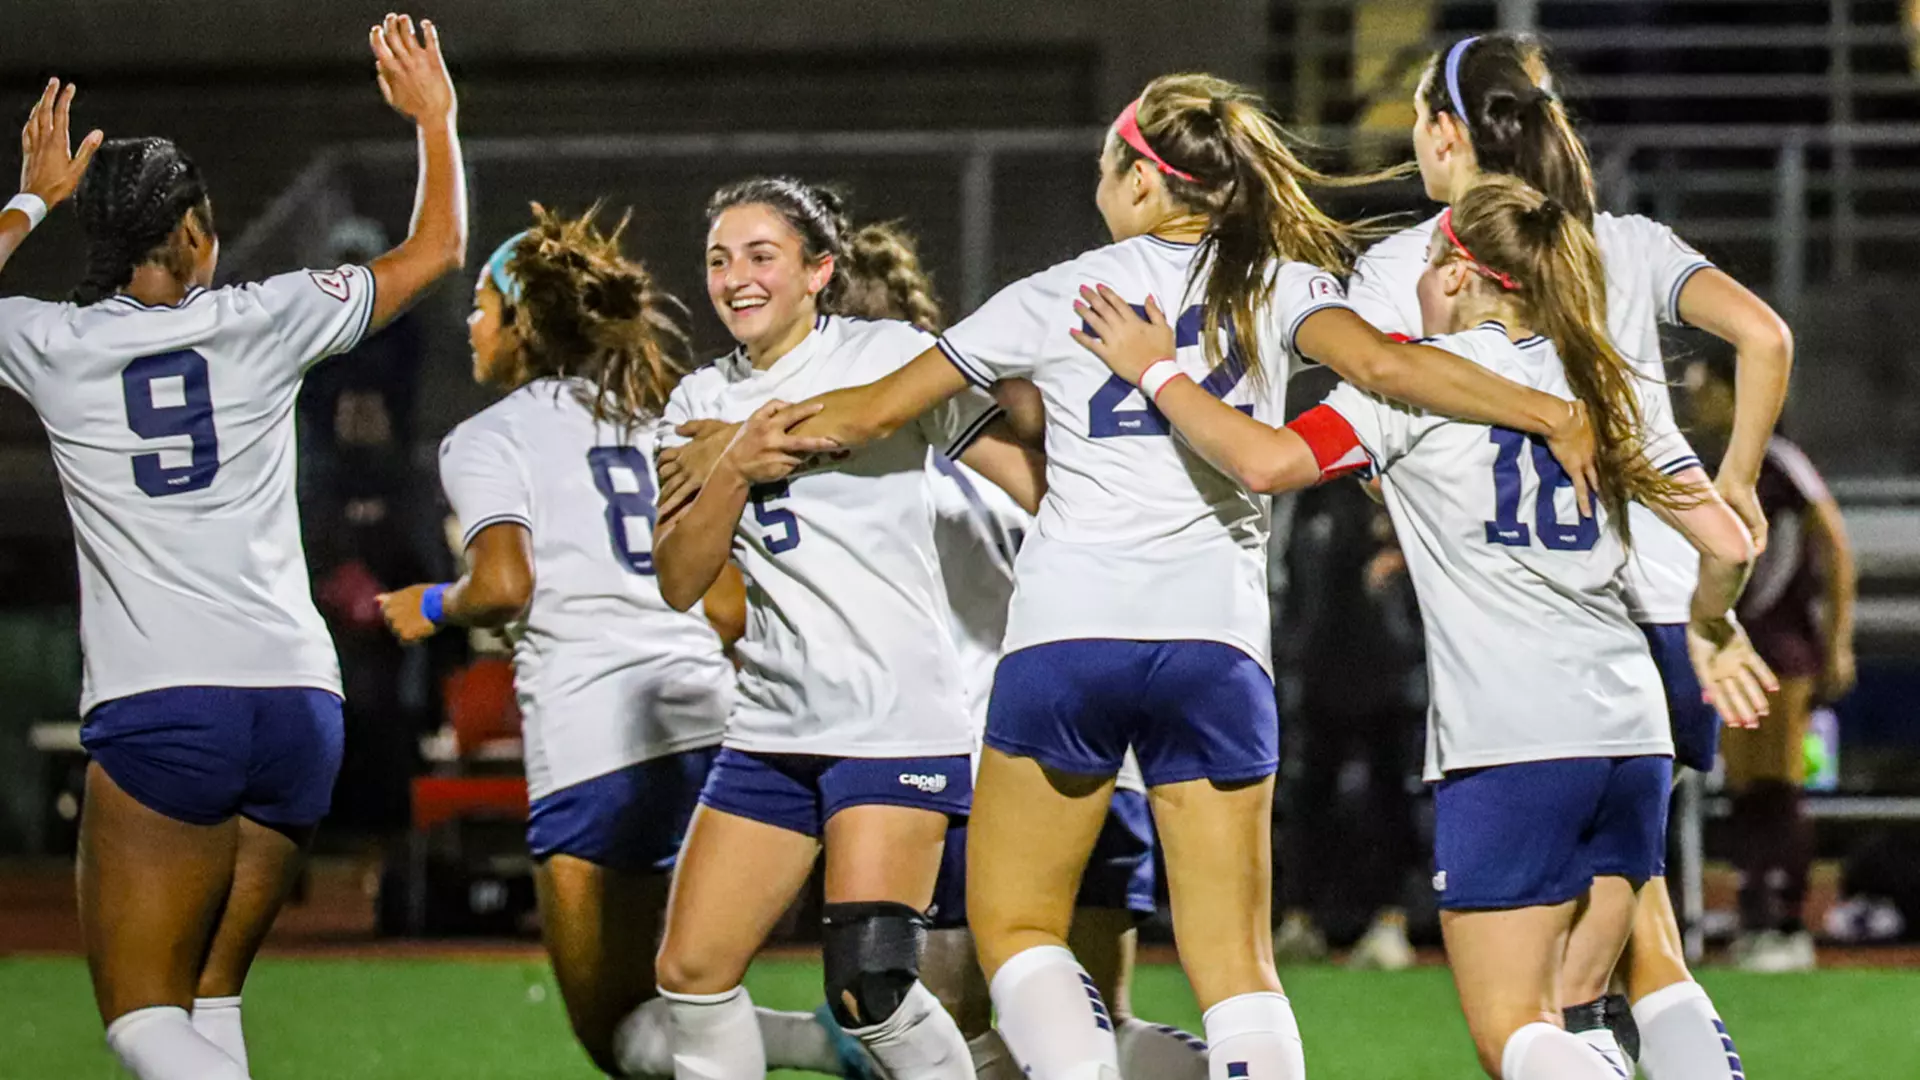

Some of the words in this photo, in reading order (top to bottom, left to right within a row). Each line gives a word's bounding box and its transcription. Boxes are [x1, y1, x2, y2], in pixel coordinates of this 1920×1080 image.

[122, 348, 219, 498] 9
[587, 446, 658, 576] 8
[752, 478, 800, 555] 5
